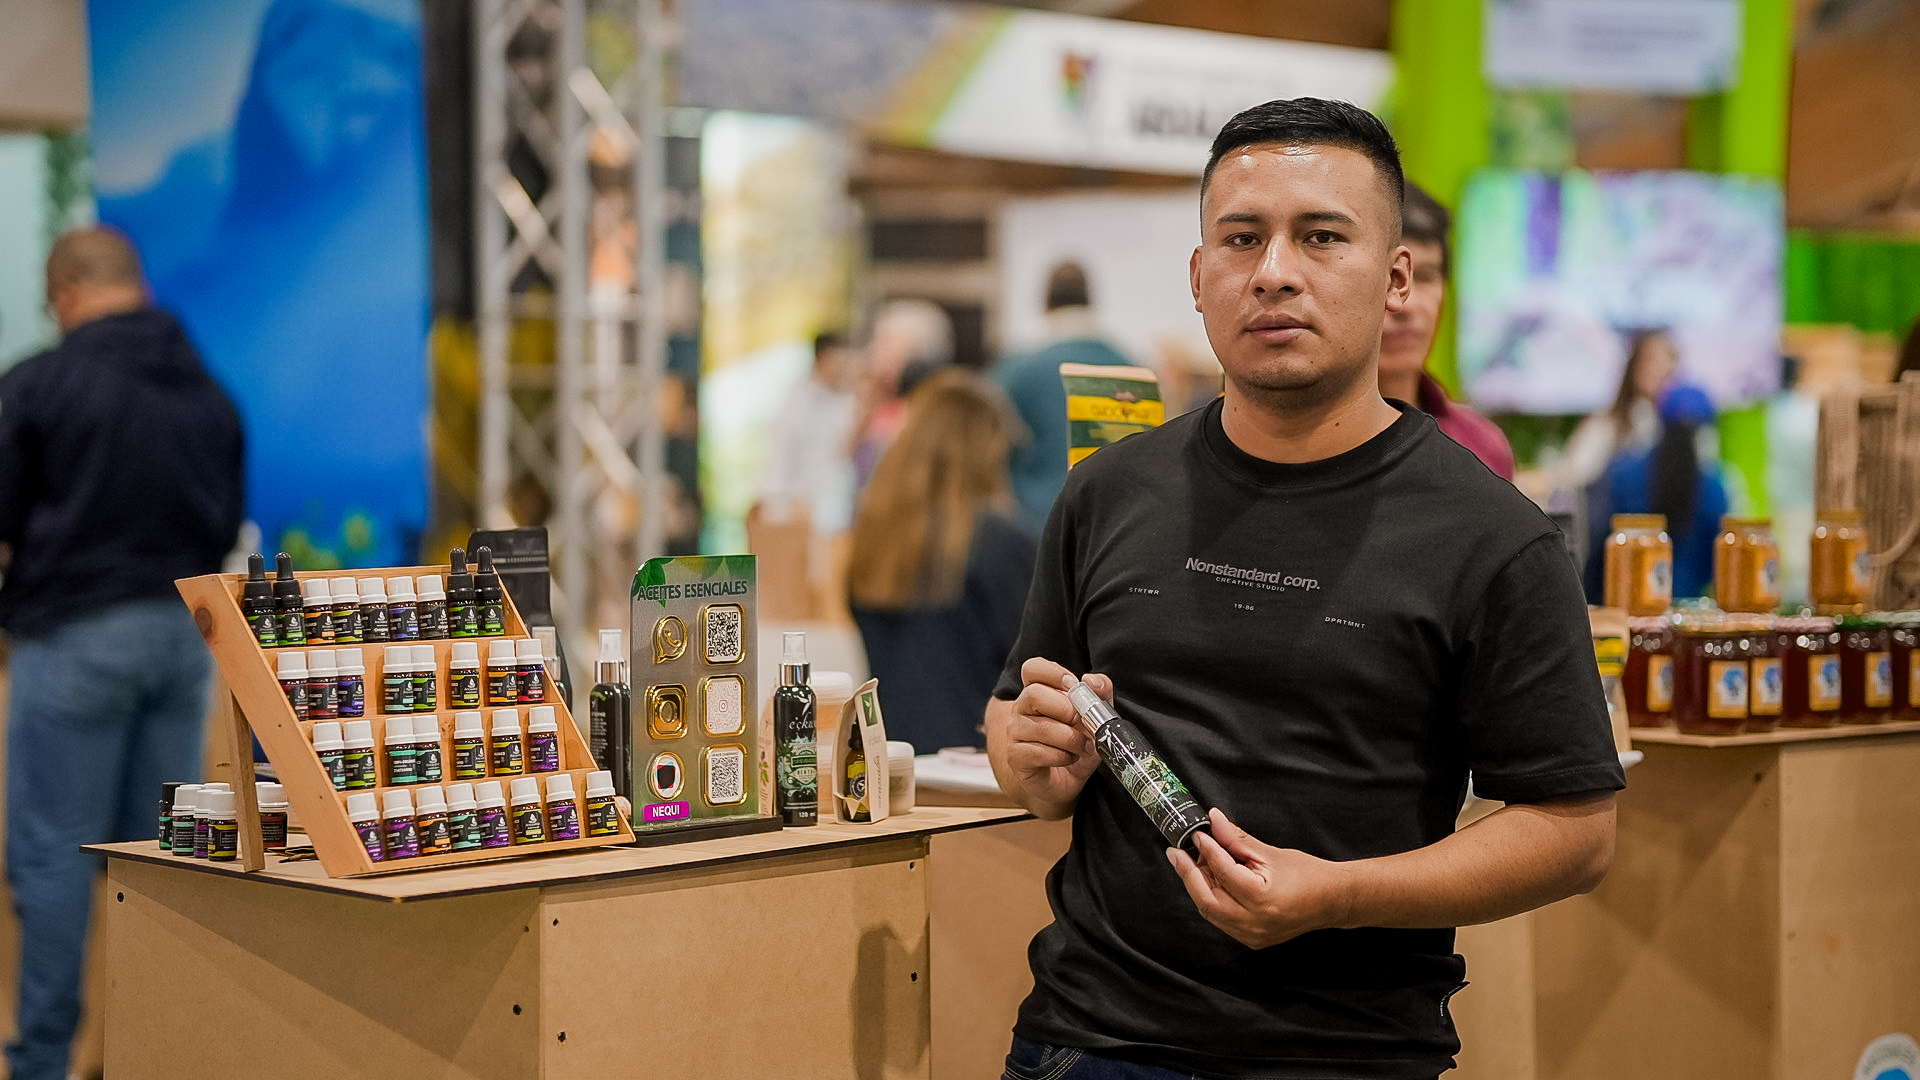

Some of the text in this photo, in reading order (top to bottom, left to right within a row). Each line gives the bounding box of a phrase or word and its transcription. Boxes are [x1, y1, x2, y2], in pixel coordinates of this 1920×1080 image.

[1185, 557, 1321, 592] Nonstandard corp.
[637, 580, 747, 601] ACEITES ESENCIALES
[1215, 576, 1285, 592] CREATIVE STUDIO
[1324, 616, 1366, 629] DPRTMNT
[652, 804, 680, 818] NEQUI
